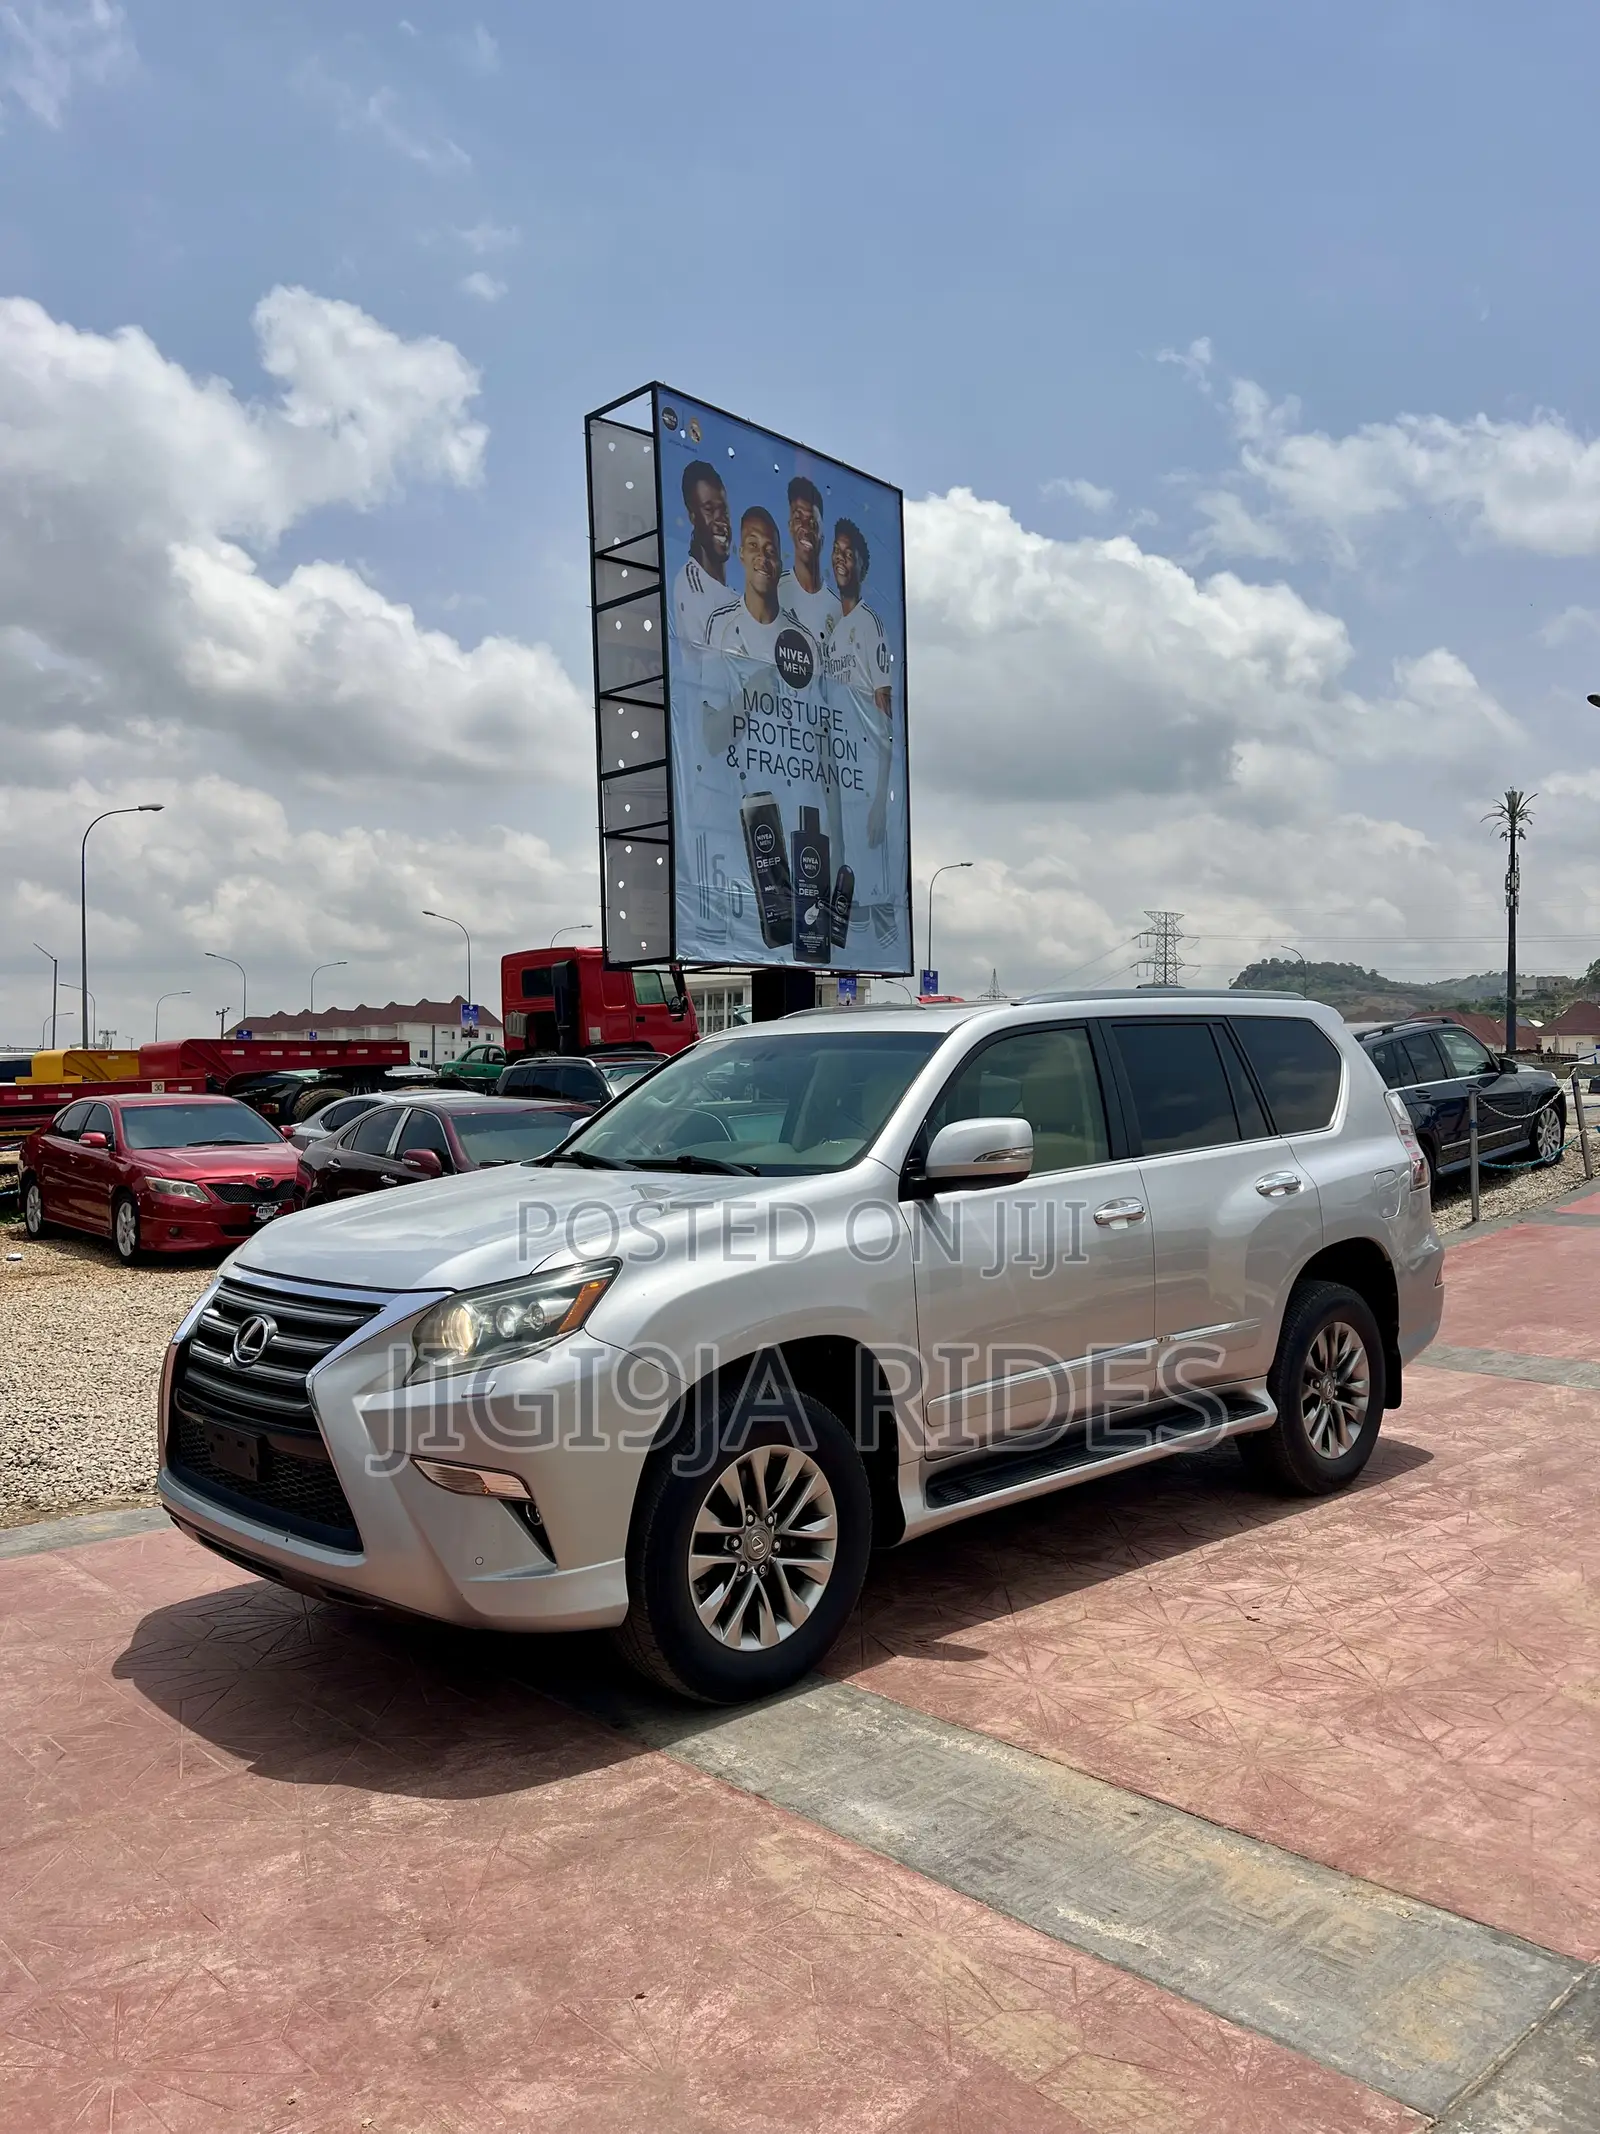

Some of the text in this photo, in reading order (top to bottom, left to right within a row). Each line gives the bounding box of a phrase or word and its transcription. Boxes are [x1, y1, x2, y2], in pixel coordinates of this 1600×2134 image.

[779, 646, 811, 665] NIVEA
[783, 661, 807, 676] MEN
[742, 687, 848, 737] MOISTURE,
[733, 715, 858, 762] PROTECTION
[726, 744, 864, 791] & FRAGRANCE
[756, 833, 773, 842] NIVEA
[756, 856, 781, 869] DEEP
[802, 856, 819, 866] NIVEA
[798, 887, 819, 896] DEEP
[154, 1083, 163, 1092] 30
